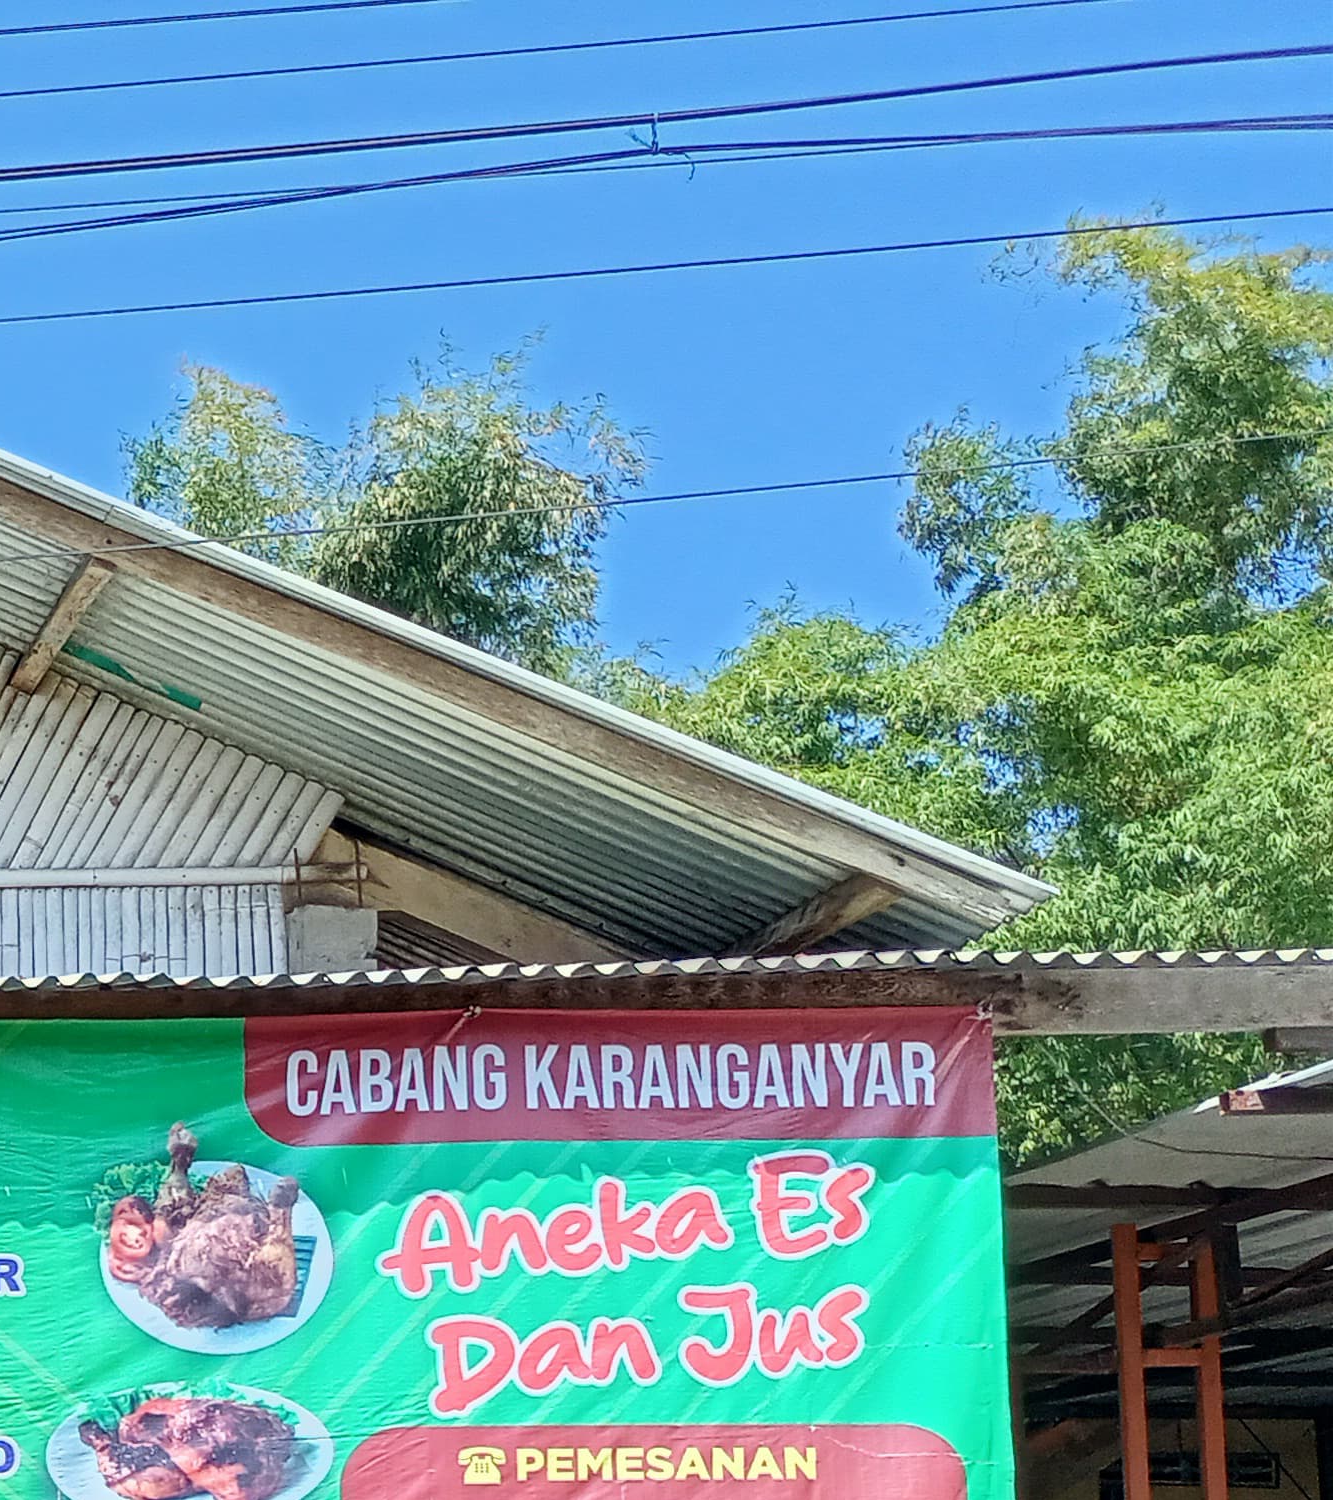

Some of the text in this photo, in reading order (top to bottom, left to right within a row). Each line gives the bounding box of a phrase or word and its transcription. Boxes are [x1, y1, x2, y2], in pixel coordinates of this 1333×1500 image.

[285, 1041, 937, 1117] CABANG KARANGANYAR
[380, 1151, 873, 1294] Aneka Es
[430, 1286, 866, 1415] Dan Jus
[515, 1446, 819, 1483] PEMESANAN
